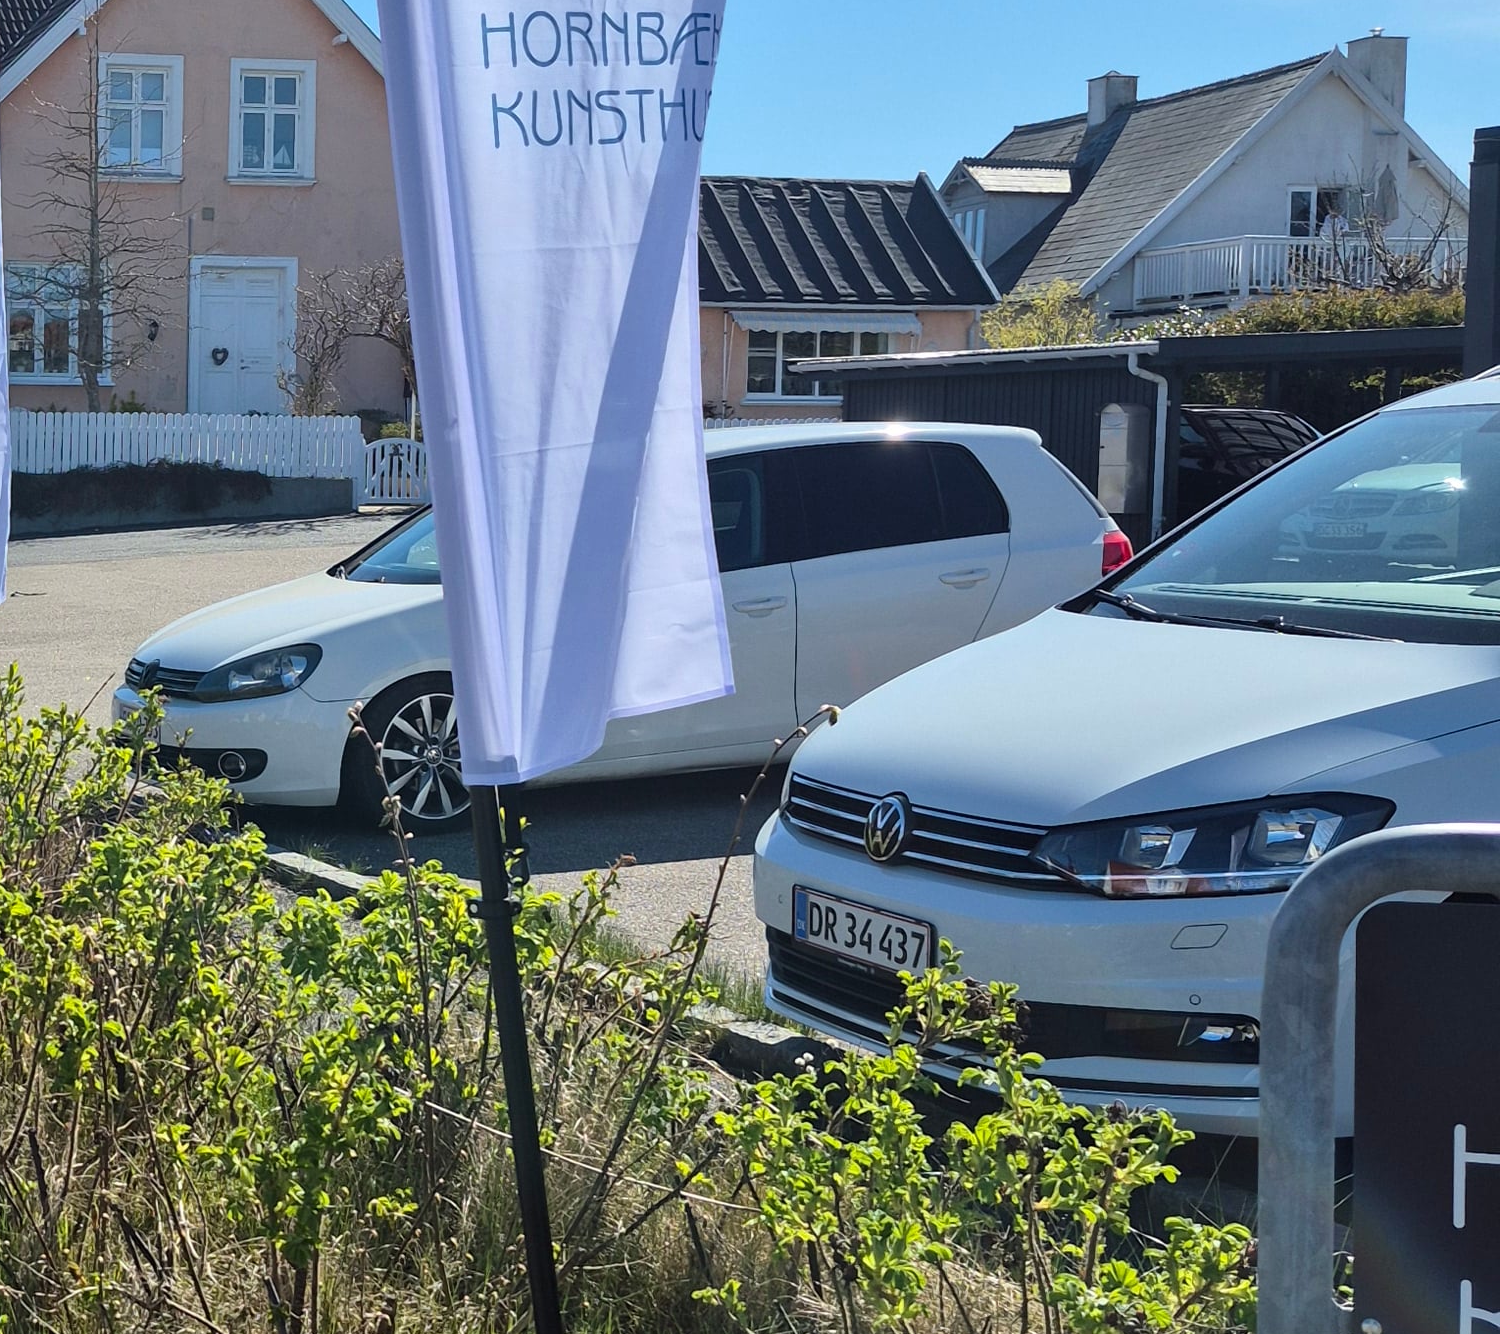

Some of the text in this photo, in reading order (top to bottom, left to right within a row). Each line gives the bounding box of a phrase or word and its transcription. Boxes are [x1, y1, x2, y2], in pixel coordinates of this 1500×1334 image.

[491, 88, 712, 149] KUNSTHU
[809, 901, 838, 944] DR
[844, 912, 873, 955] 34
[879, 923, 926, 969] 437
